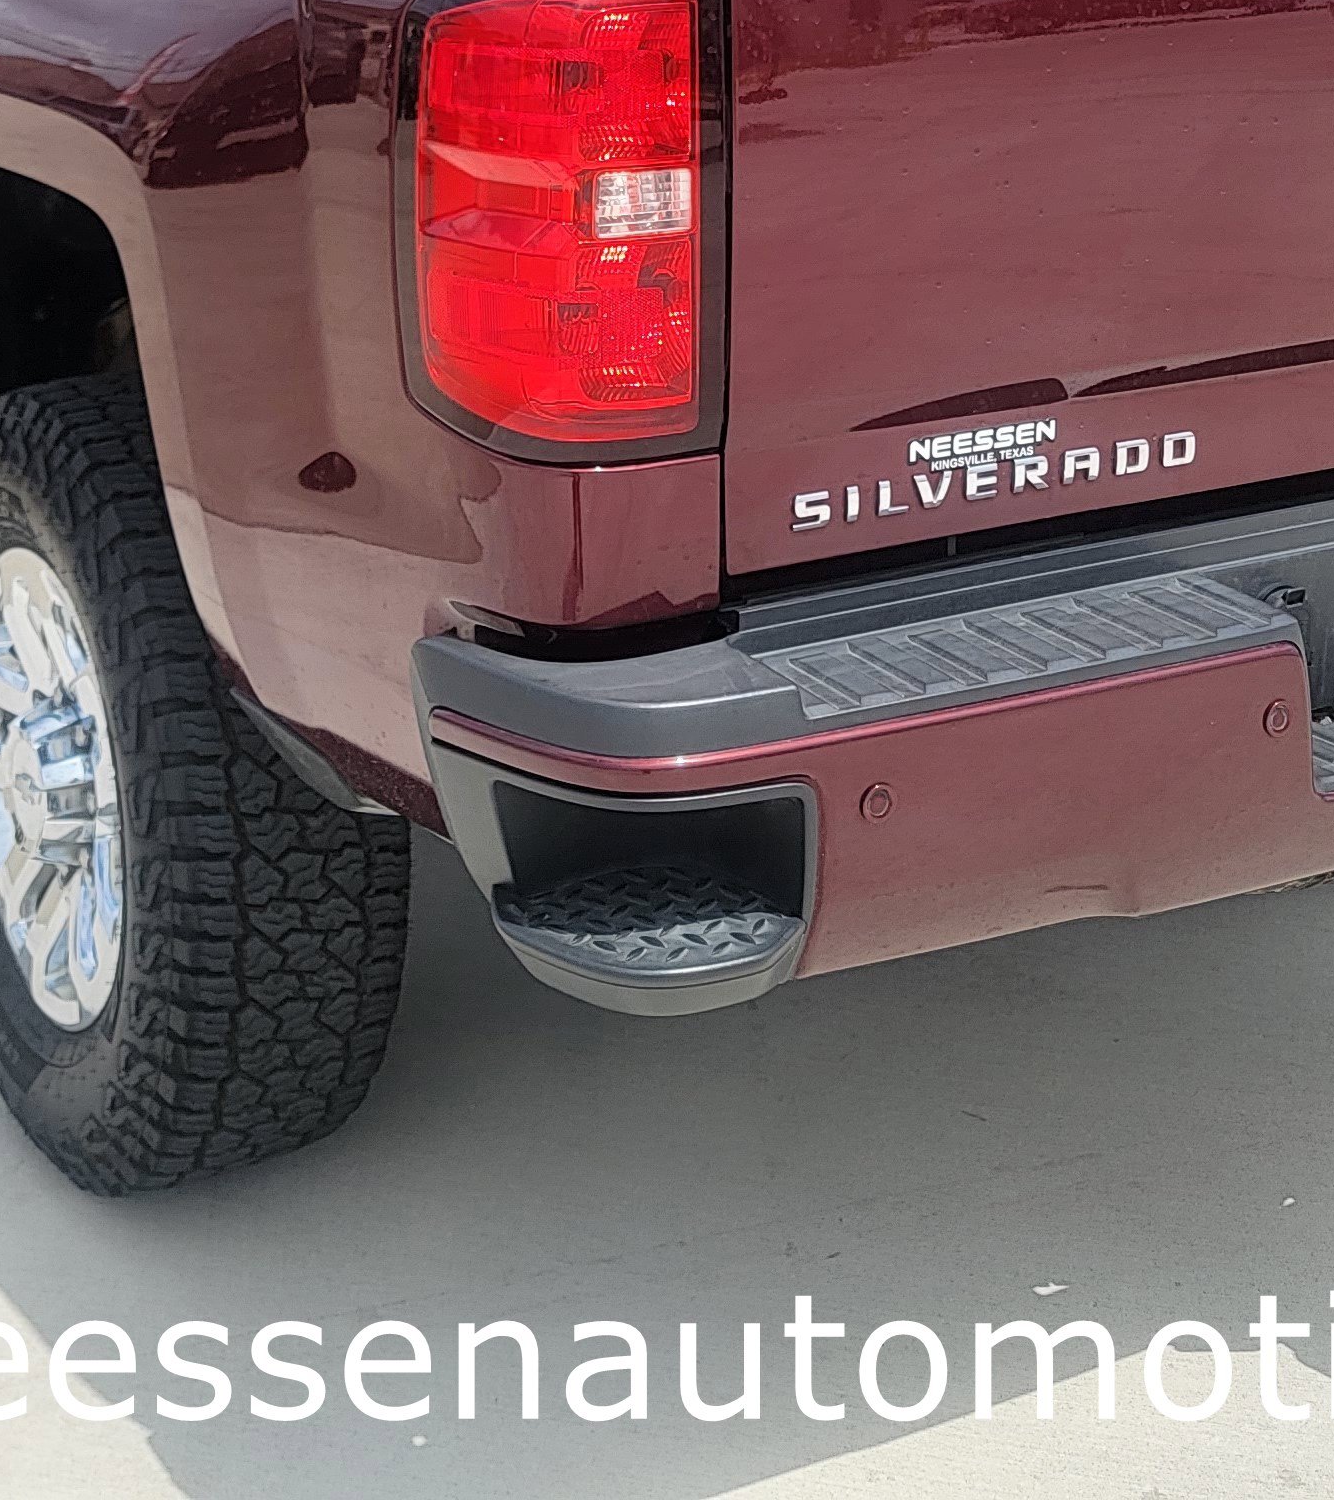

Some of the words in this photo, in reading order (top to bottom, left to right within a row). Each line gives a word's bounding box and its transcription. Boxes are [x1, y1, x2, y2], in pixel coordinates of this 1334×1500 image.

[908, 418, 1056, 463] NEESSEN
[999, 445, 1035, 461] TEXAS
[791, 430, 1198, 532] SILVERADO
